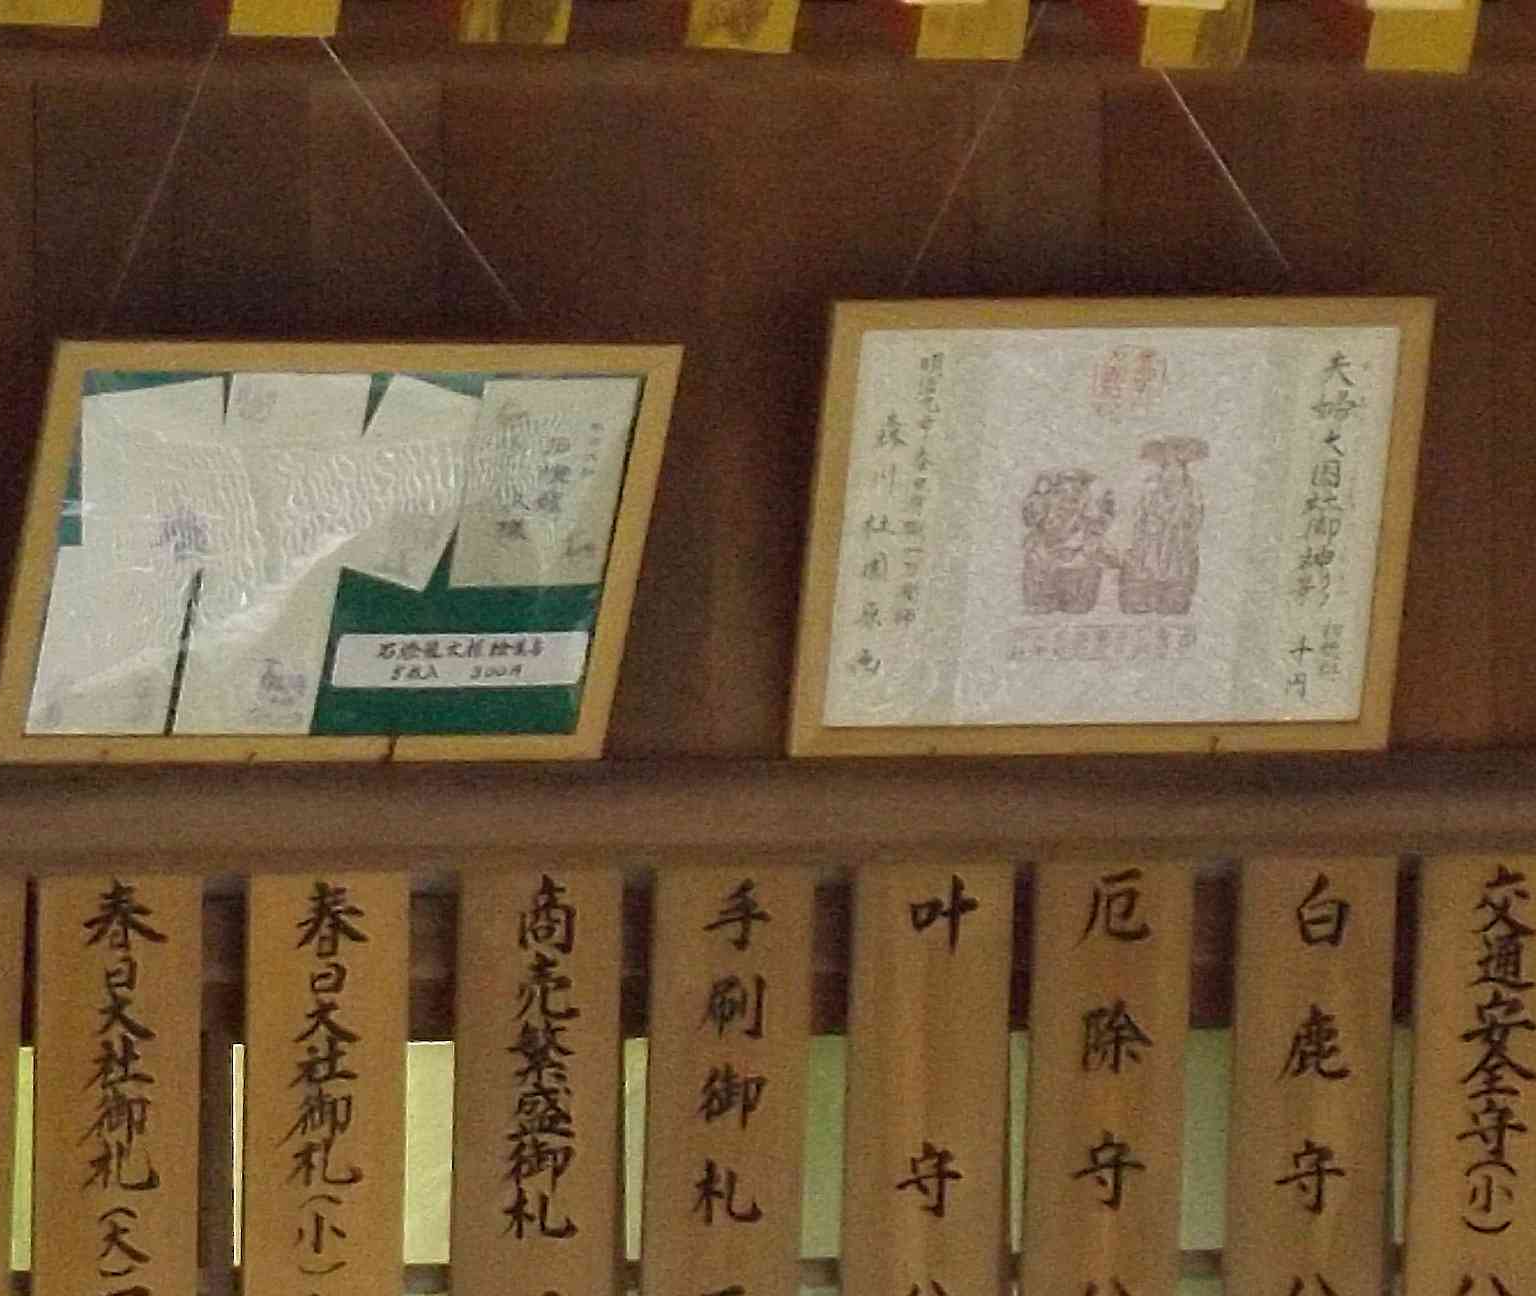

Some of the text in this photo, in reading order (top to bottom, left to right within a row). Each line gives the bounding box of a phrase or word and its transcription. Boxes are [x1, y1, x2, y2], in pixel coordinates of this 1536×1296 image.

[502, 874, 578, 1239] 商売繁盛御札
[692, 877, 772, 1226] 手刷御札
[895, 873, 978, 1218] 叶守
[1070, 867, 1155, 1211] 厄除守
[1274, 871, 1353, 1216] 白鹿守
